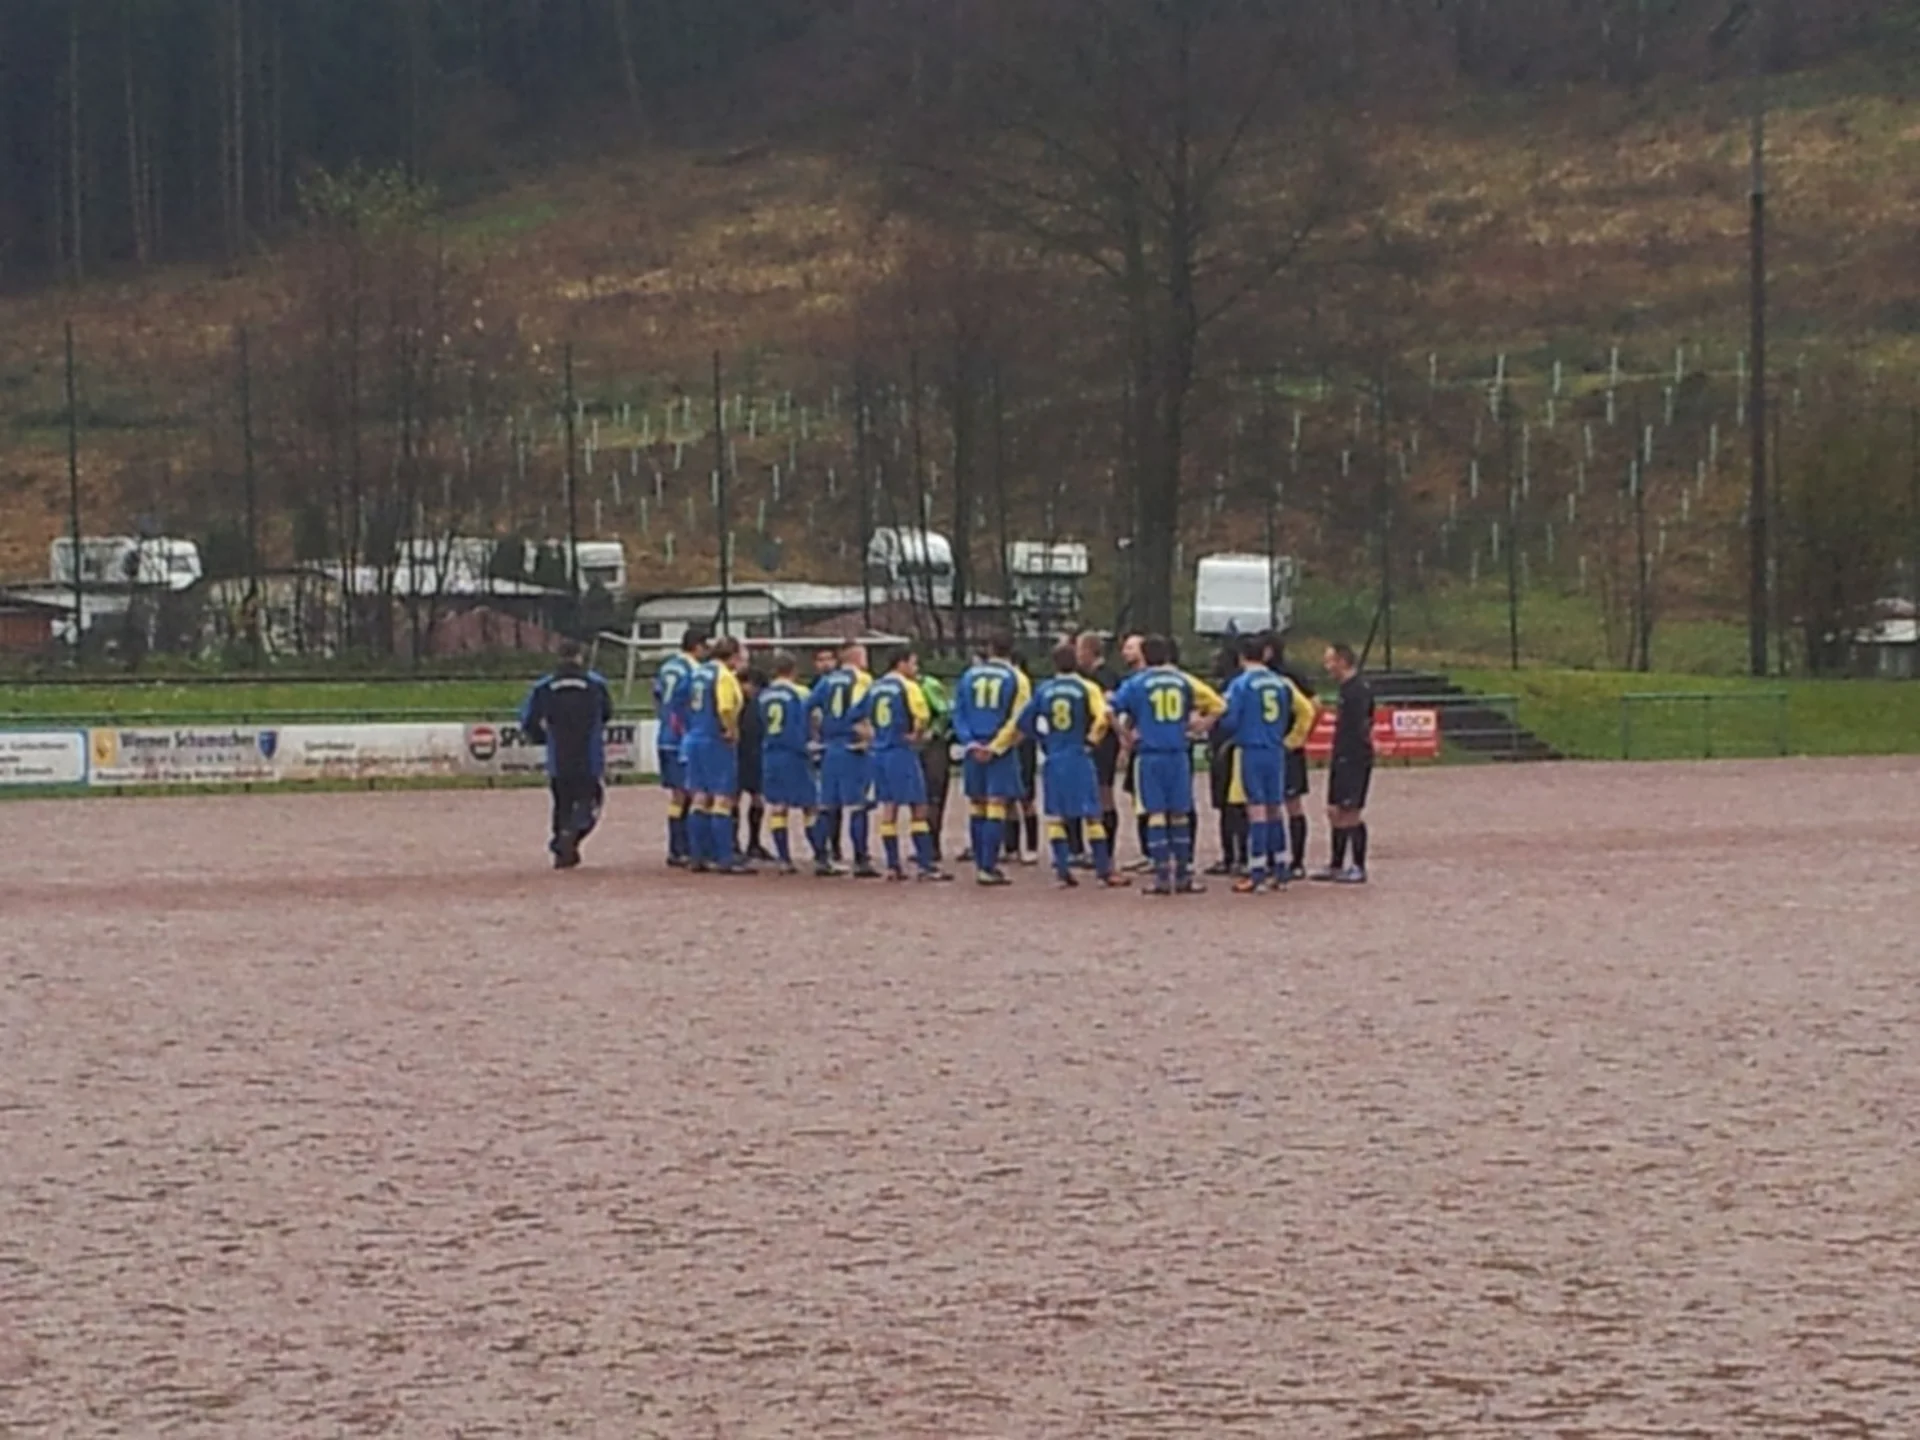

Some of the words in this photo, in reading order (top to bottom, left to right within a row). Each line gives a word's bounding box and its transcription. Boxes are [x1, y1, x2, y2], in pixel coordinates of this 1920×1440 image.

[973, 677, 1004, 709] 11
[1149, 687, 1183, 722] 10
[1262, 689, 1280, 722] 5
[766, 703, 784, 735] 2
[872, 696, 892, 728] 6
[1051, 698, 1072, 730] 8
